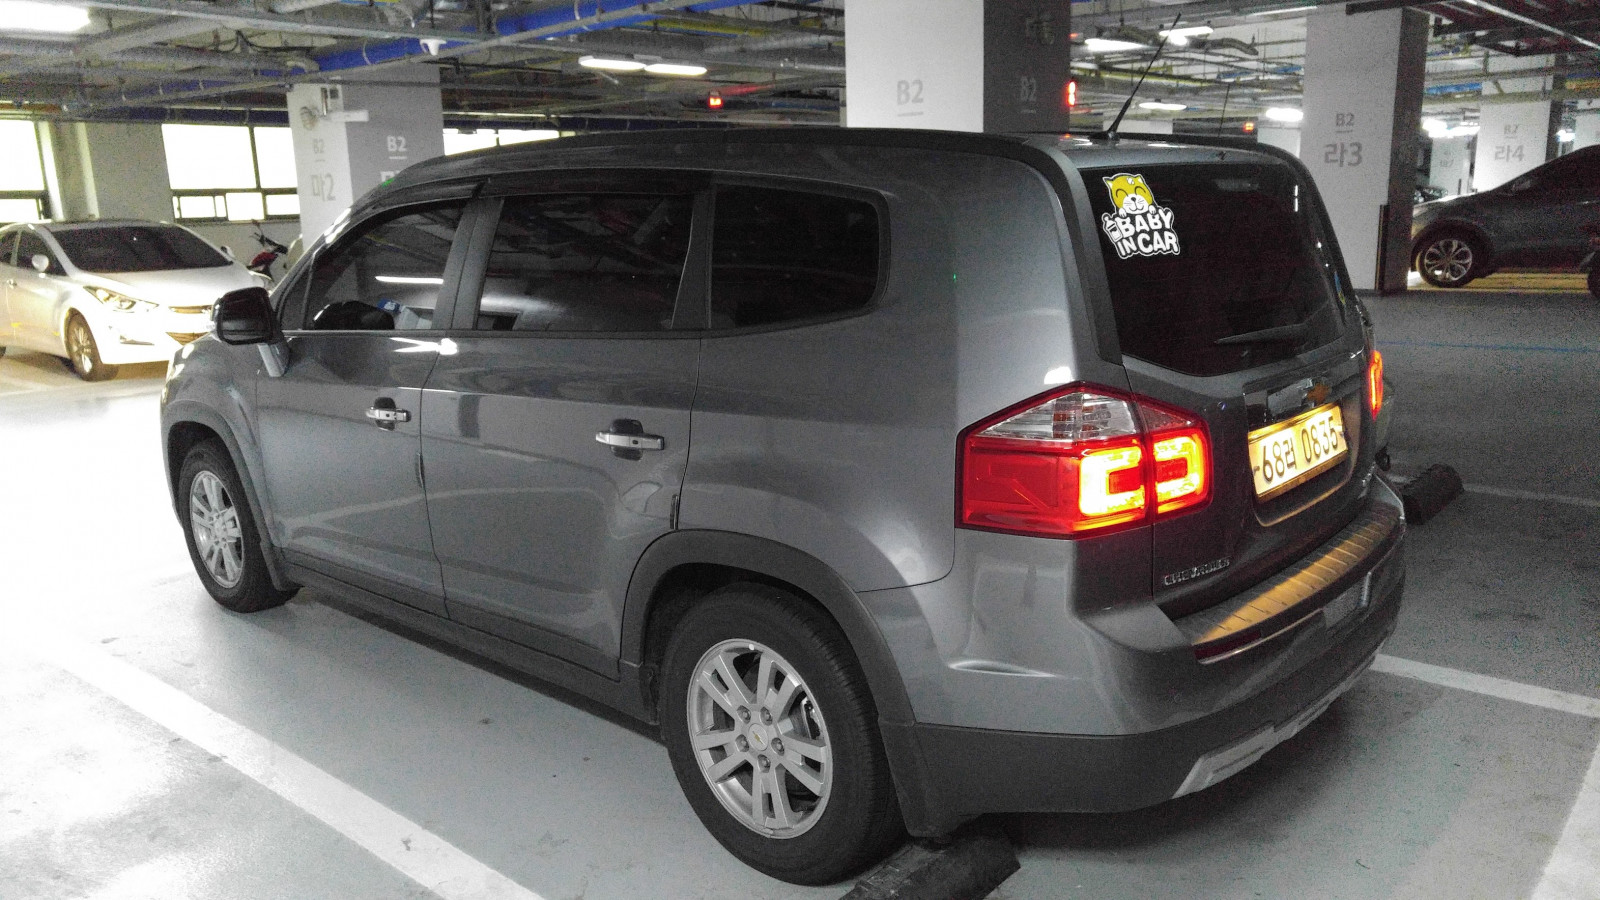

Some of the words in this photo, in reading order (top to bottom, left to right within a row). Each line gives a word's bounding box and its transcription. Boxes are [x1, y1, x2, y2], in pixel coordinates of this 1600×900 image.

[897, 79, 924, 105] B2
[1335, 112, 1355, 128] B2
[386, 134, 407, 152] B2
[1323, 141, 1363, 168] 라3
[1494, 144, 1525, 163] 라4
[1115, 208, 1172, 239] BABY
[1117, 236, 1138, 256] IN
[1137, 230, 1179, 254] CAR
[1301, 415, 1339, 464] 0835
